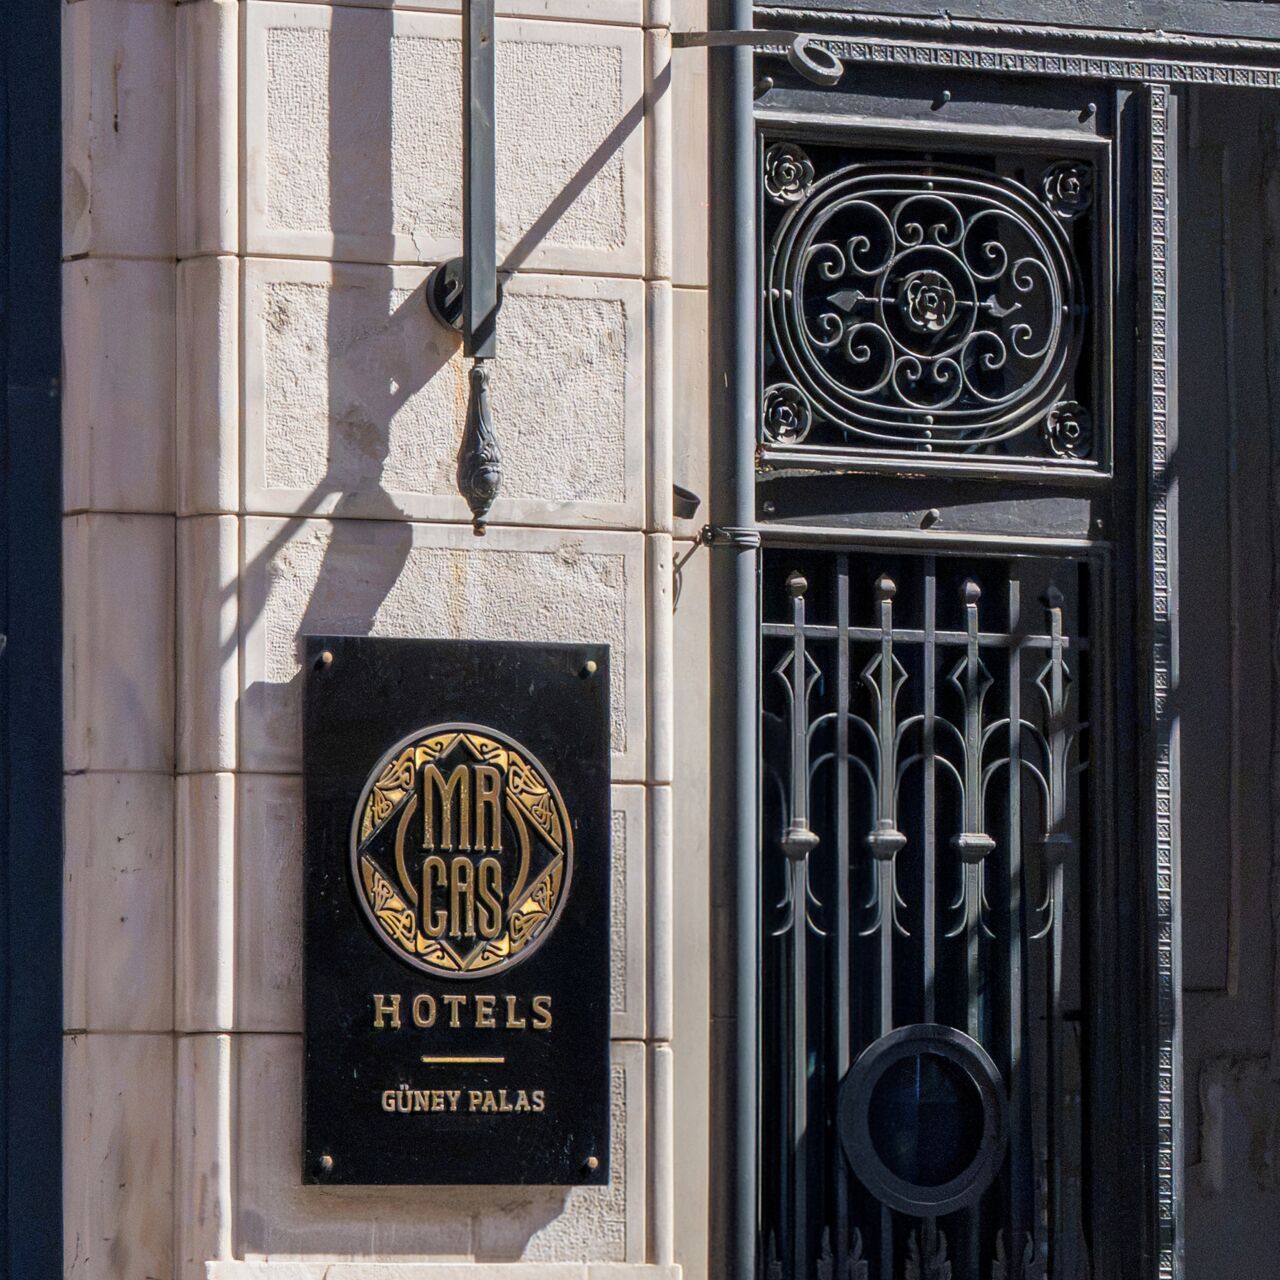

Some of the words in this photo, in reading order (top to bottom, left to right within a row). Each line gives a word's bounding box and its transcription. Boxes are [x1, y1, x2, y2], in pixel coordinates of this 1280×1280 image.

[423, 763, 503, 852] MR
[421, 856, 503, 939] CAS
[372, 993, 553, 1030] HOTELS
[381, 1084, 461, 1113] GÜNEY
[468, 1088, 545, 1113] PALAS
